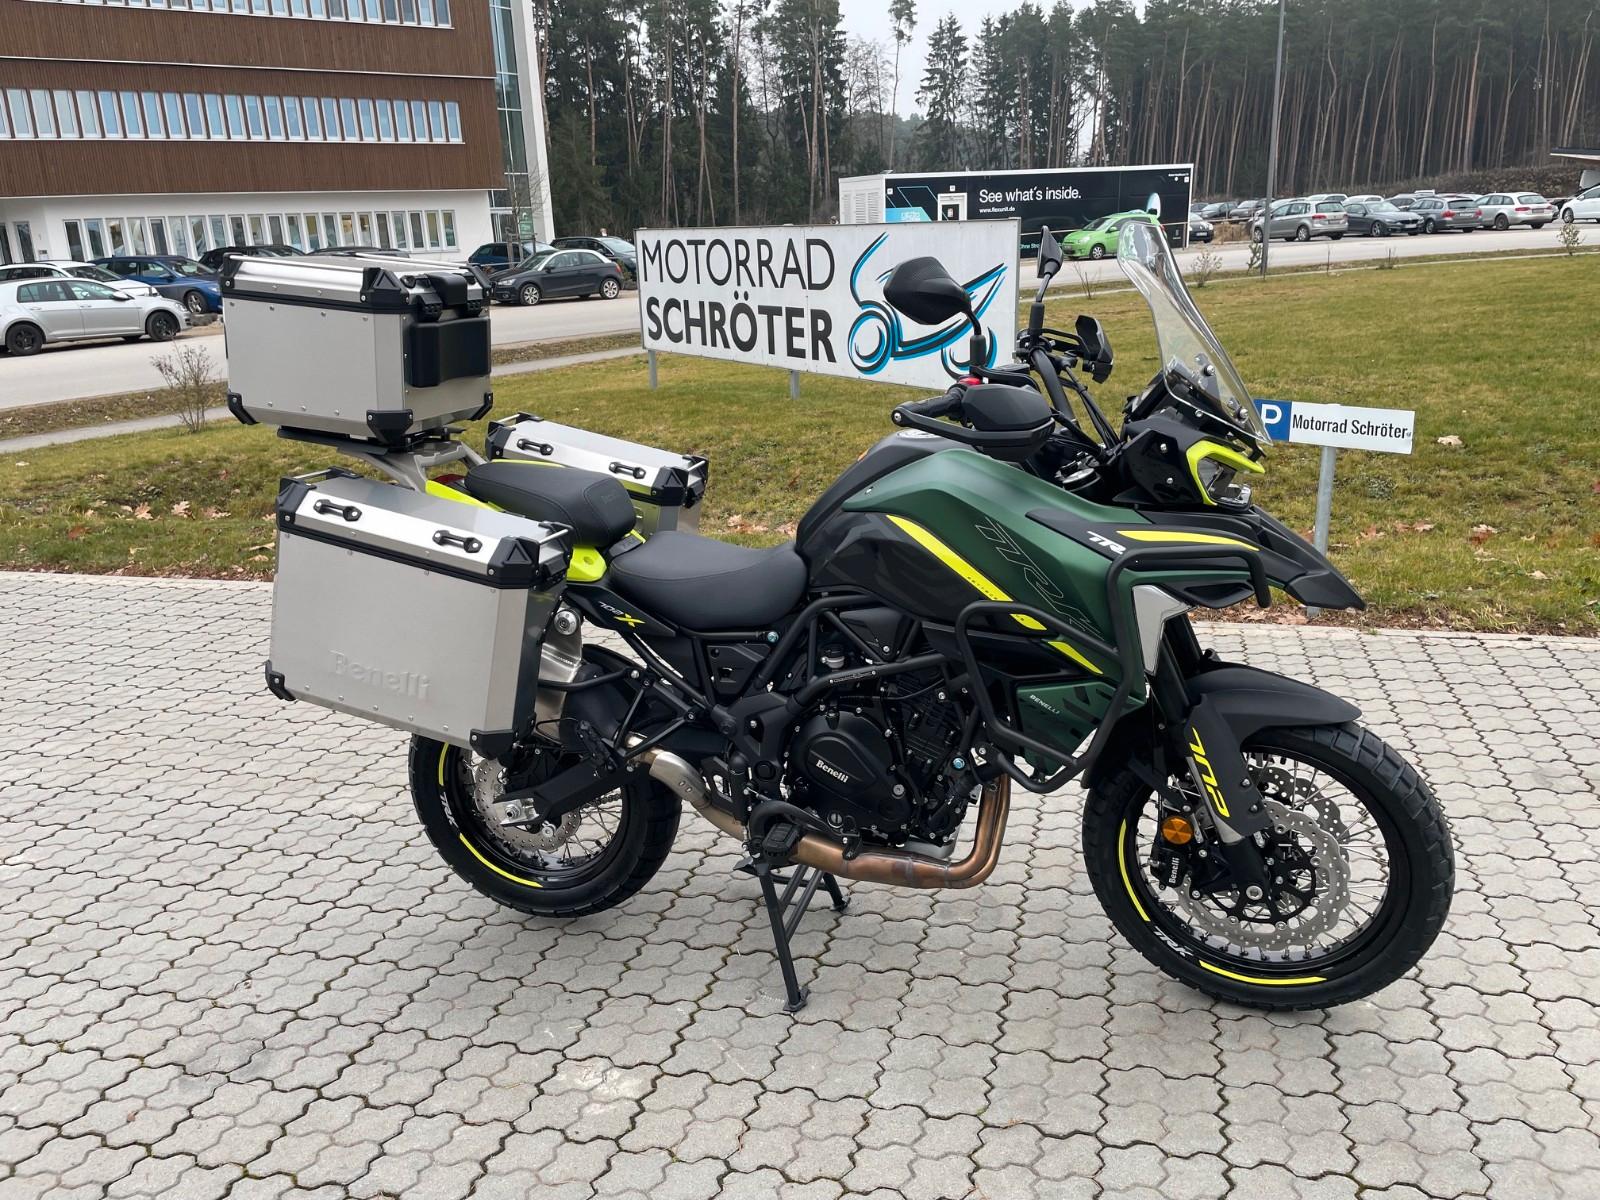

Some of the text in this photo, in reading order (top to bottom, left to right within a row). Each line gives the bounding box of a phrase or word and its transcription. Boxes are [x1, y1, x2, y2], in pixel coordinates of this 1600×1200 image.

[979, 189, 1003, 203] See
[1045, 186, 1082, 200] inside.
[642, 238, 835, 290] MOTORRAD
[646, 290, 837, 363] SCHRÖTER
[1261, 403, 1408, 439] P Motorrad Schröter
[1029, 694, 1060, 714] BENELLI
[815, 759, 849, 783] Benelli
[1168, 857, 1180, 884] Benelli
